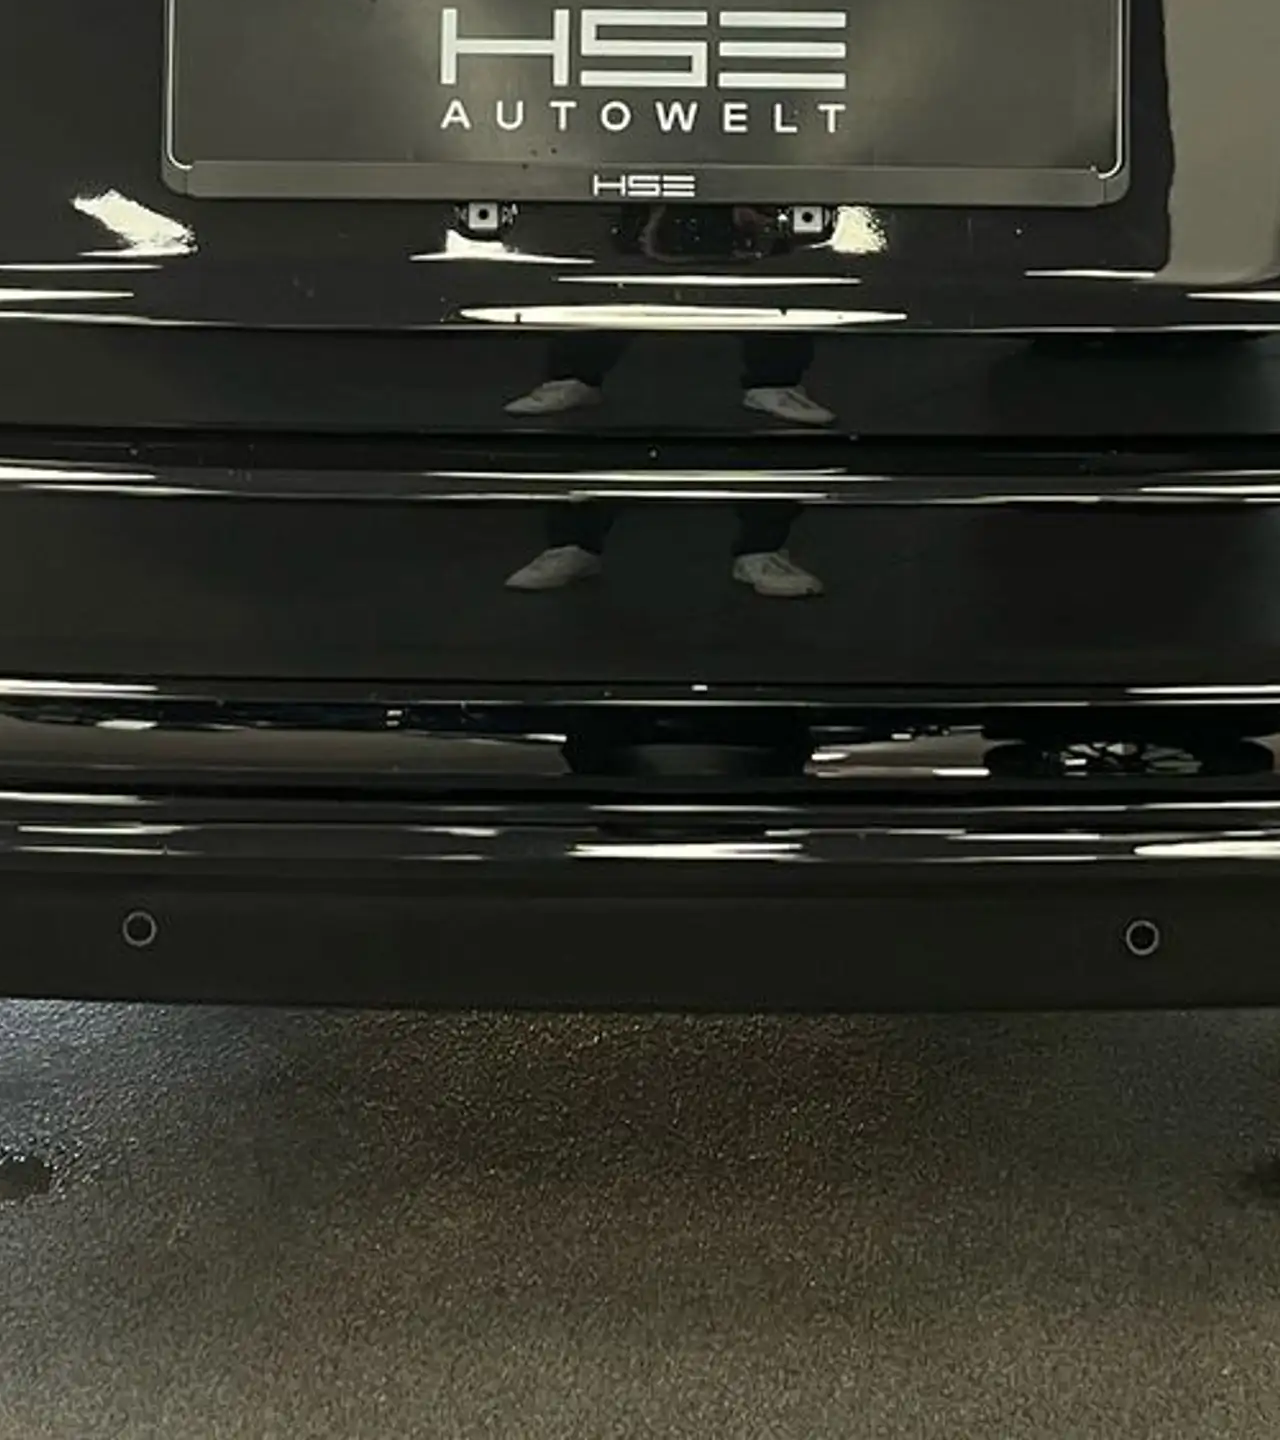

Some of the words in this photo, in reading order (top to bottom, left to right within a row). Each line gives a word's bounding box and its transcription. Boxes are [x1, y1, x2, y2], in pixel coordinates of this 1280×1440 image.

[439, 7, 848, 90] HSE
[439, 98, 848, 135] AUTOWELT
[592, 173, 696, 199] HSE
